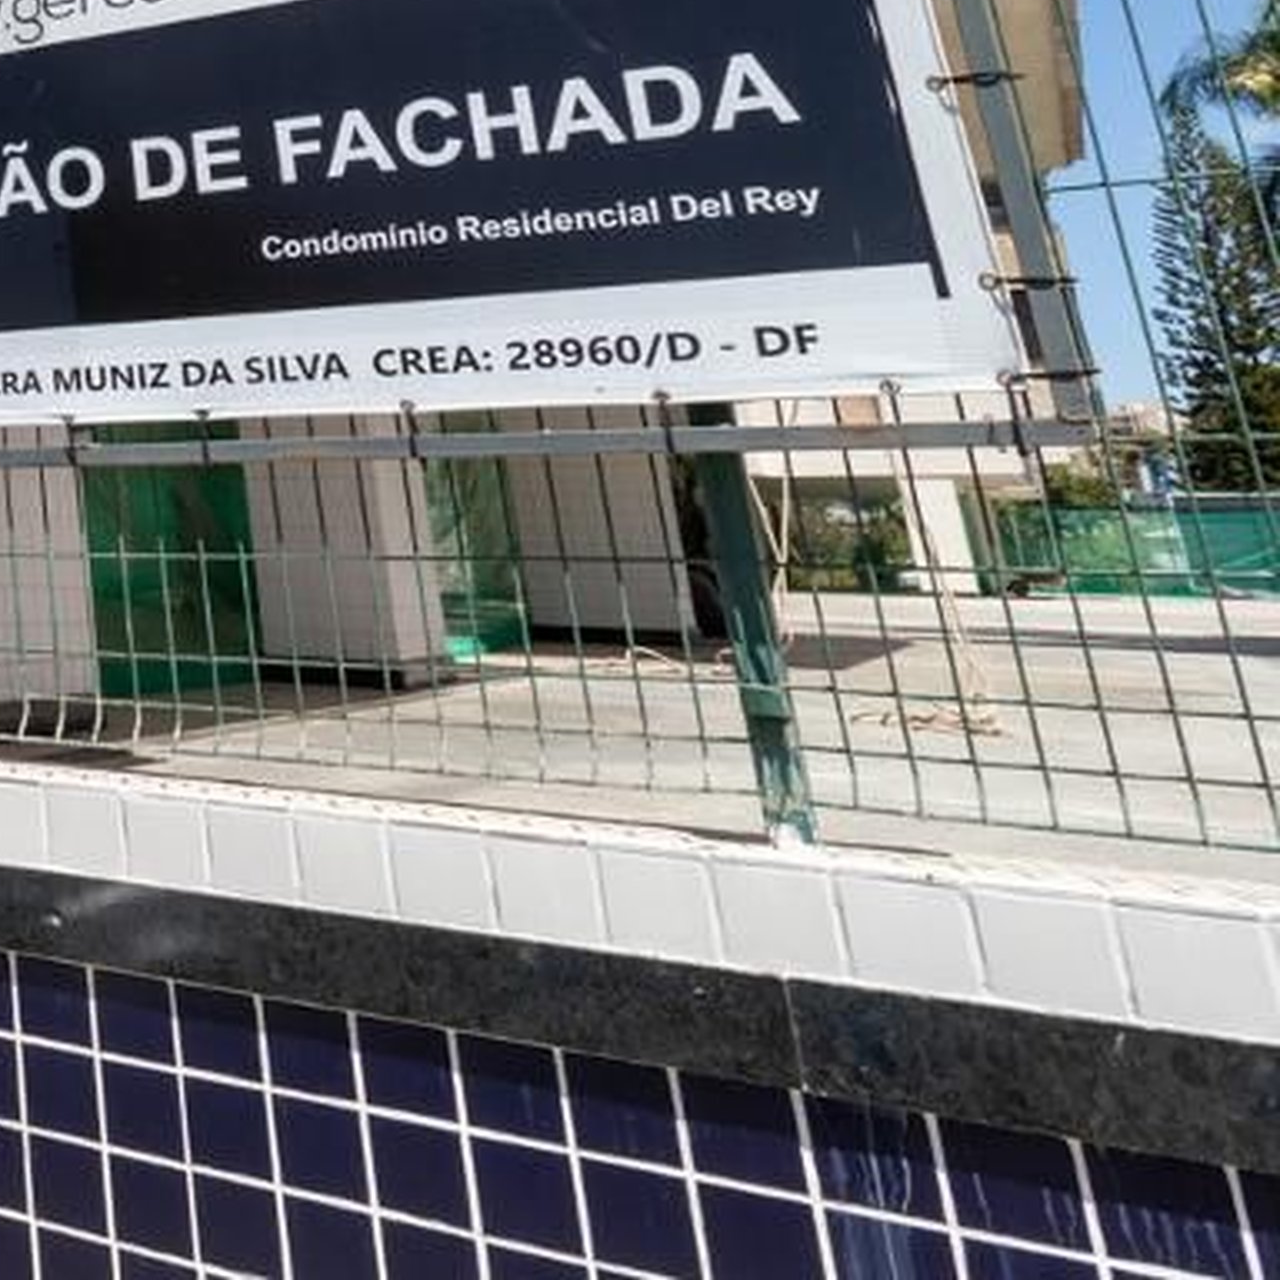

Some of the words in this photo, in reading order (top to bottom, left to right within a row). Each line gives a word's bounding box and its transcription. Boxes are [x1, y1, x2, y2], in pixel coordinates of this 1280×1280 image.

[130, 125, 249, 201] DE
[272, 52, 802, 185] FACHADA
[261, 220, 449, 262] Condomínio
[457, 197, 661, 242] Residencial
[670, 187, 733, 223] Del
[742, 185, 821, 218] Rey
[52, 361, 171, 394] MUNIZ
[181, 358, 233, 388] DA
[246, 352, 349, 385] SILVA
[373, 345, 493, 377] CREA:
[507, 331, 701, 371] 28960/D
[754, 323, 820, 359] DF
